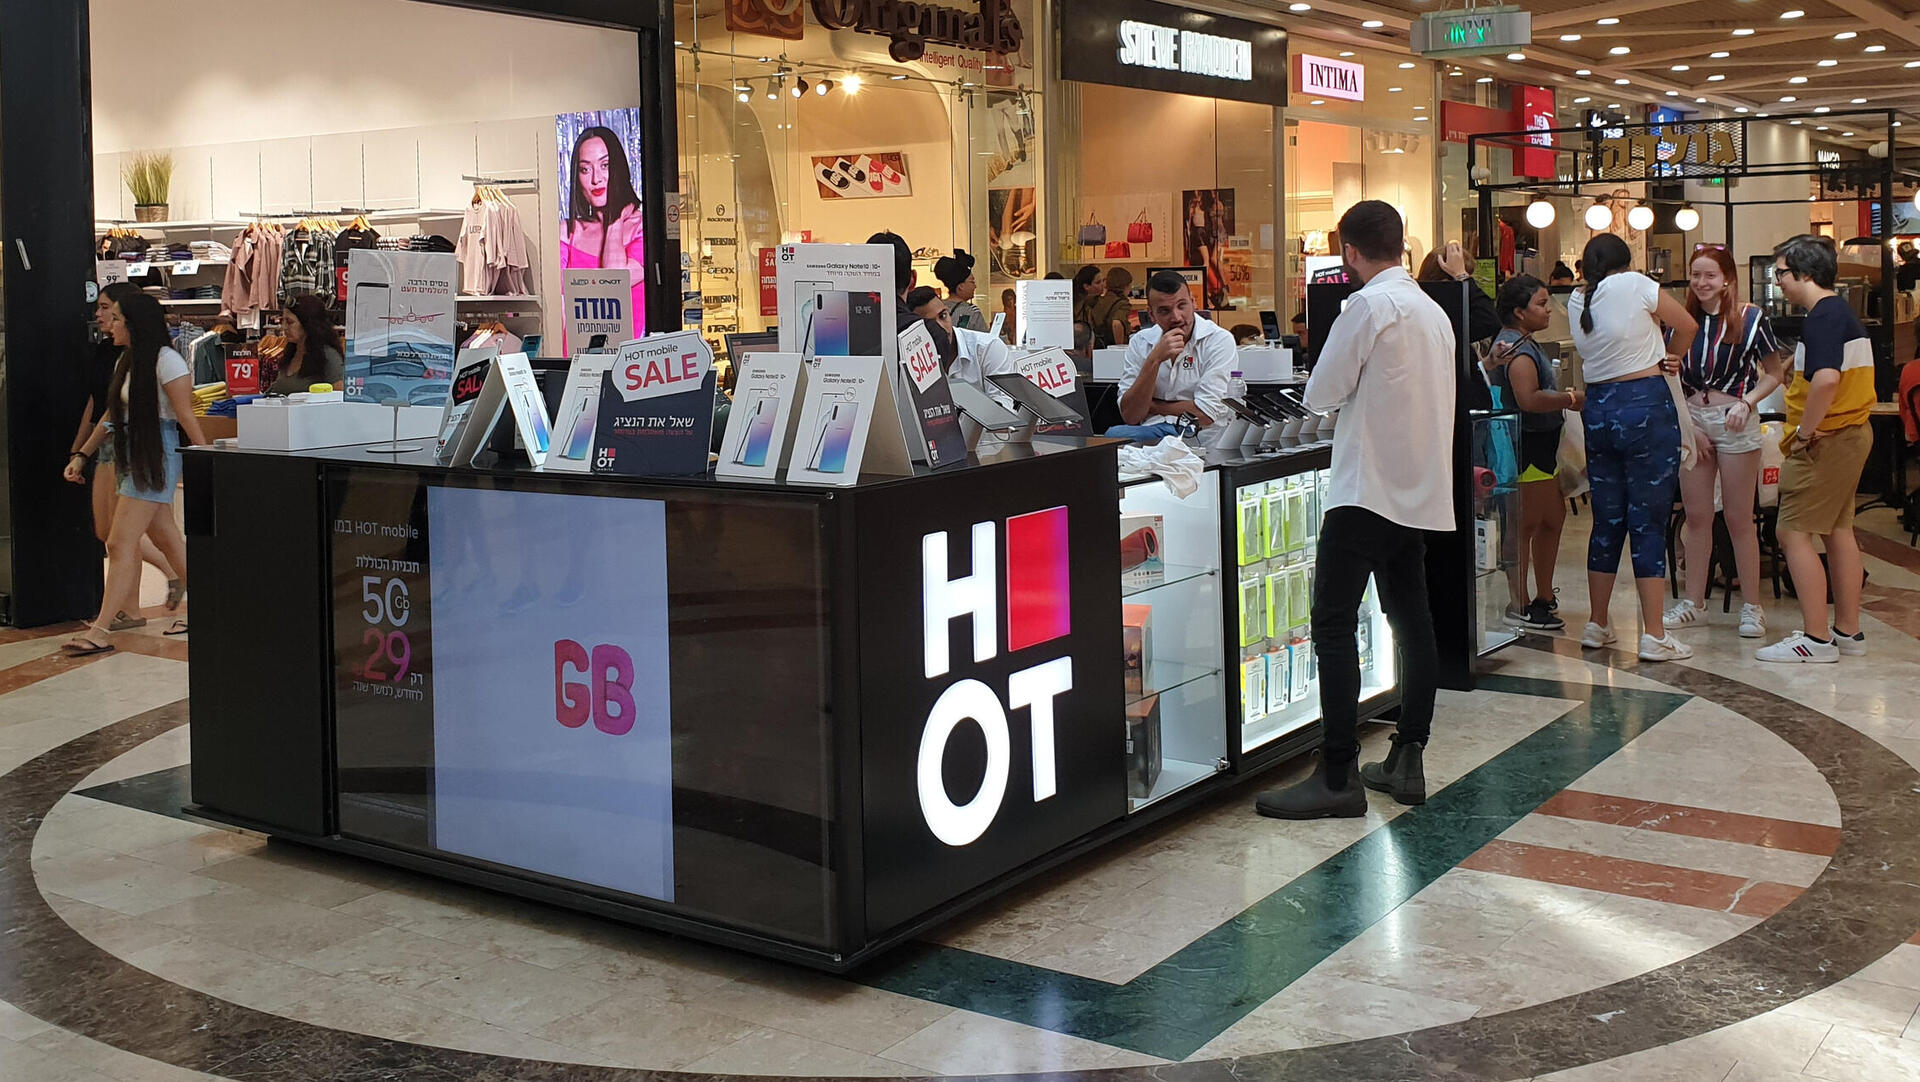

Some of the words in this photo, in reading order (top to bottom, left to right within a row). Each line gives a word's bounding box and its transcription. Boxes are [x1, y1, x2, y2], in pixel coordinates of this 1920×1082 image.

[1118, 20, 1179, 71] STEVE
[1181, 30, 1252, 81] MADDEN
[957, 54, 984, 73] Quality
[1310, 63, 1358, 92] INTIMA
[1601, 125, 1737, 170] גולדה
[574, 297, 621, 320] תודה
[577, 322, 621, 334] שהשתתפתן
[624, 351, 644, 362] HOT
[646, 343, 679, 356] mobile
[231, 363, 251, 379] 79
[624, 352, 700, 391] SALE
[910, 342, 938, 383] SALE
[1020, 362, 1034, 373] HOT
[1034, 356, 1053, 368] mobile
[1026, 362, 1072, 390] ALE
[456, 375, 483, 399] SAL
[613, 418, 645, 427] הנציג
[648, 417, 666, 427] את
[669, 415, 695, 427] שאל
[355, 521, 378, 536] HOT
[381, 525, 419, 539] mobile
[356, 555, 390, 571] הכוללת
[392, 559, 420, 573] תכנית
[362, 575, 410, 627] 50
[394, 596, 410, 610] Gb
[364, 627, 411, 683] 29
[353, 680, 369, 692] שנה
[410, 672, 424, 686] רק
[554, 638, 636, 736] GB
[371, 683, 394, 698] למשך
[394, 687, 424, 702] לחודש,
